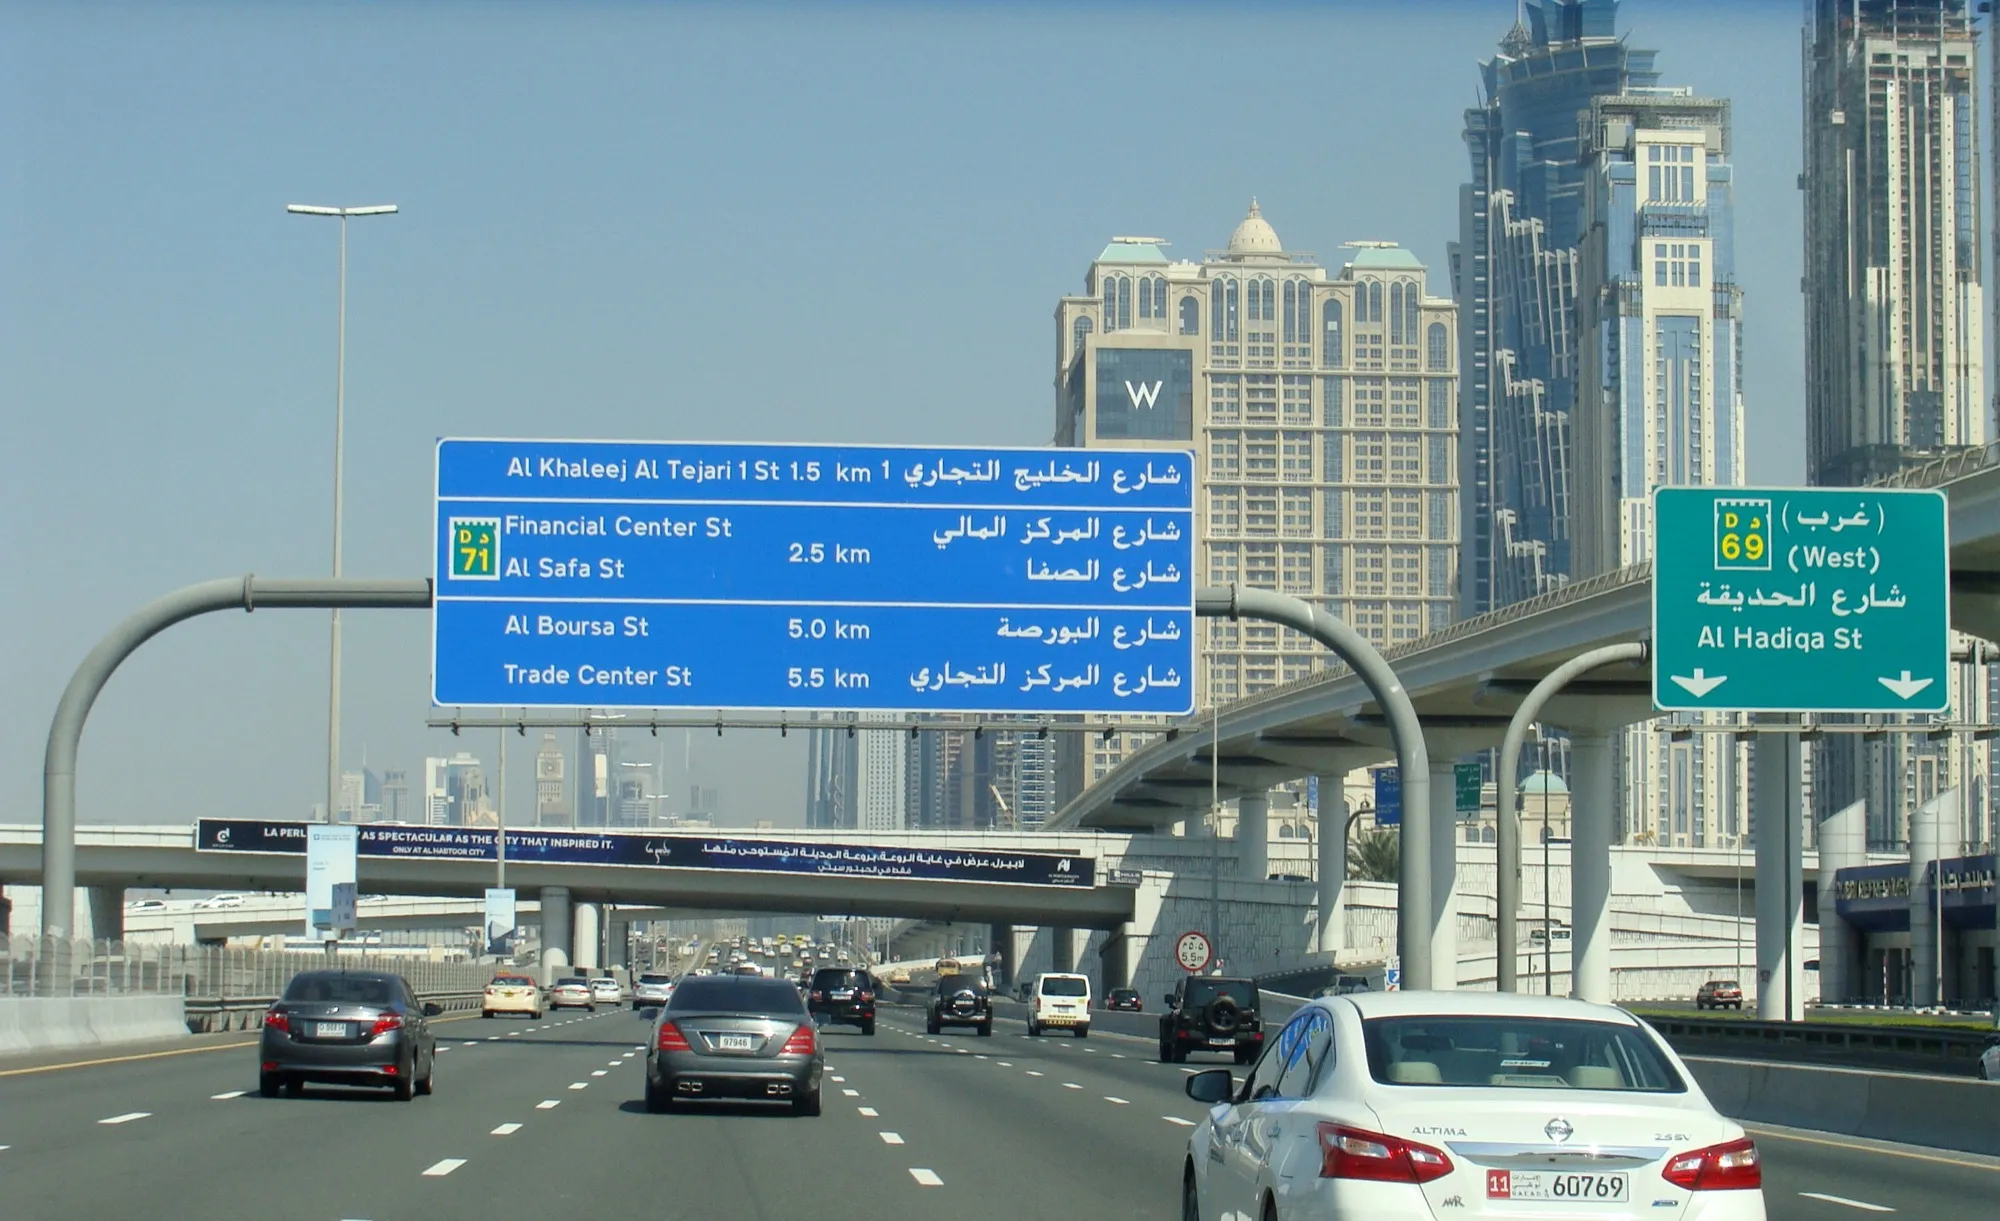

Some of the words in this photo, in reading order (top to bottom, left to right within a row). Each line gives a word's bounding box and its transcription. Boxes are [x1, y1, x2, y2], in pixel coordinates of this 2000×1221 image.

[1125, 380, 1163, 410] W
[508, 458, 532, 477] Al
[540, 458, 627, 482] Khaleej
[635, 460, 659, 479] Al
[668, 460, 731, 483] Tejari
[739, 461, 747, 480] 1
[755, 461, 780, 481] St
[791, 462, 821, 482] 1.5
[836, 462, 871, 482] km
[881, 461, 889, 480] 1
[904, 458, 1000, 489] التجاري
[1014, 460, 1100, 492] الخليج
[1112, 462, 1181, 494] شارع
[505, 516, 607, 535] Financial
[615, 516, 697, 537] Center
[706, 518, 732, 538] St
[932, 515, 1006, 549] المالي
[1020, 517, 1100, 545] المركز
[1725, 513, 1739, 528] D
[1750, 517, 1761, 529] د
[459, 529, 472, 544] D
[479, 533, 490, 544] د
[1112, 518, 1181, 549] شارع
[788, 543, 825, 563] 2.5
[835, 544, 870, 563] km
[1722, 533, 1764, 560] 69
[460, 547, 488, 572] 71
[505, 558, 531, 577] Al
[539, 558, 591, 578] Safa
[599, 559, 625, 579] St
[1027, 558, 1100, 581] الصفا
[1788, 545, 1880, 574] (West)
[1112, 560, 1181, 592] شارع
[1697, 582, 1815, 612] الحديقة
[1831, 583, 1906, 616] شارع
[504, 616, 530, 635] Al
[538, 616, 615, 636] Boursa
[623, 617, 649, 637] St
[788, 618, 826, 639] 5.0
[835, 619, 870, 639] km
[997, 616, 1100, 646] البورصة
[1112, 617, 1181, 649] شارع
[1698, 626, 1725, 648] Al
[1734, 627, 1824, 653] Hadiqa
[1834, 628, 1862, 649] St
[504, 665, 570, 685] Trade
[578, 665, 658, 686] Center
[666, 666, 692, 686] St
[788, 667, 825, 688] 5.5
[835, 668, 870, 688] km
[910, 661, 1006, 693] التجاري
[1020, 663, 1100, 692] المركز
[1112, 664, 1181, 696] شارع
[264, 828, 278, 837] LA
[361, 831, 376, 840] AS
[378, 831, 453, 843] SPECTACULAR
[455, 834, 469, 844] AS
[471, 835, 492, 844] THE
[494, 836, 519, 845] CTY
[520, 836, 549, 846] THAT
[550, 838, 599, 849] INSPIRED
[601, 840, 614, 849] IT.
[392, 846, 412, 854] ONLY
[468, 848, 486, 856] CITY
[723, 1037, 748, 1046] 97946
[1412, 1126, 1468, 1137] ALTIMA
[1489, 1175, 1510, 1192] 11
[1553, 1175, 1624, 1198] 60769
